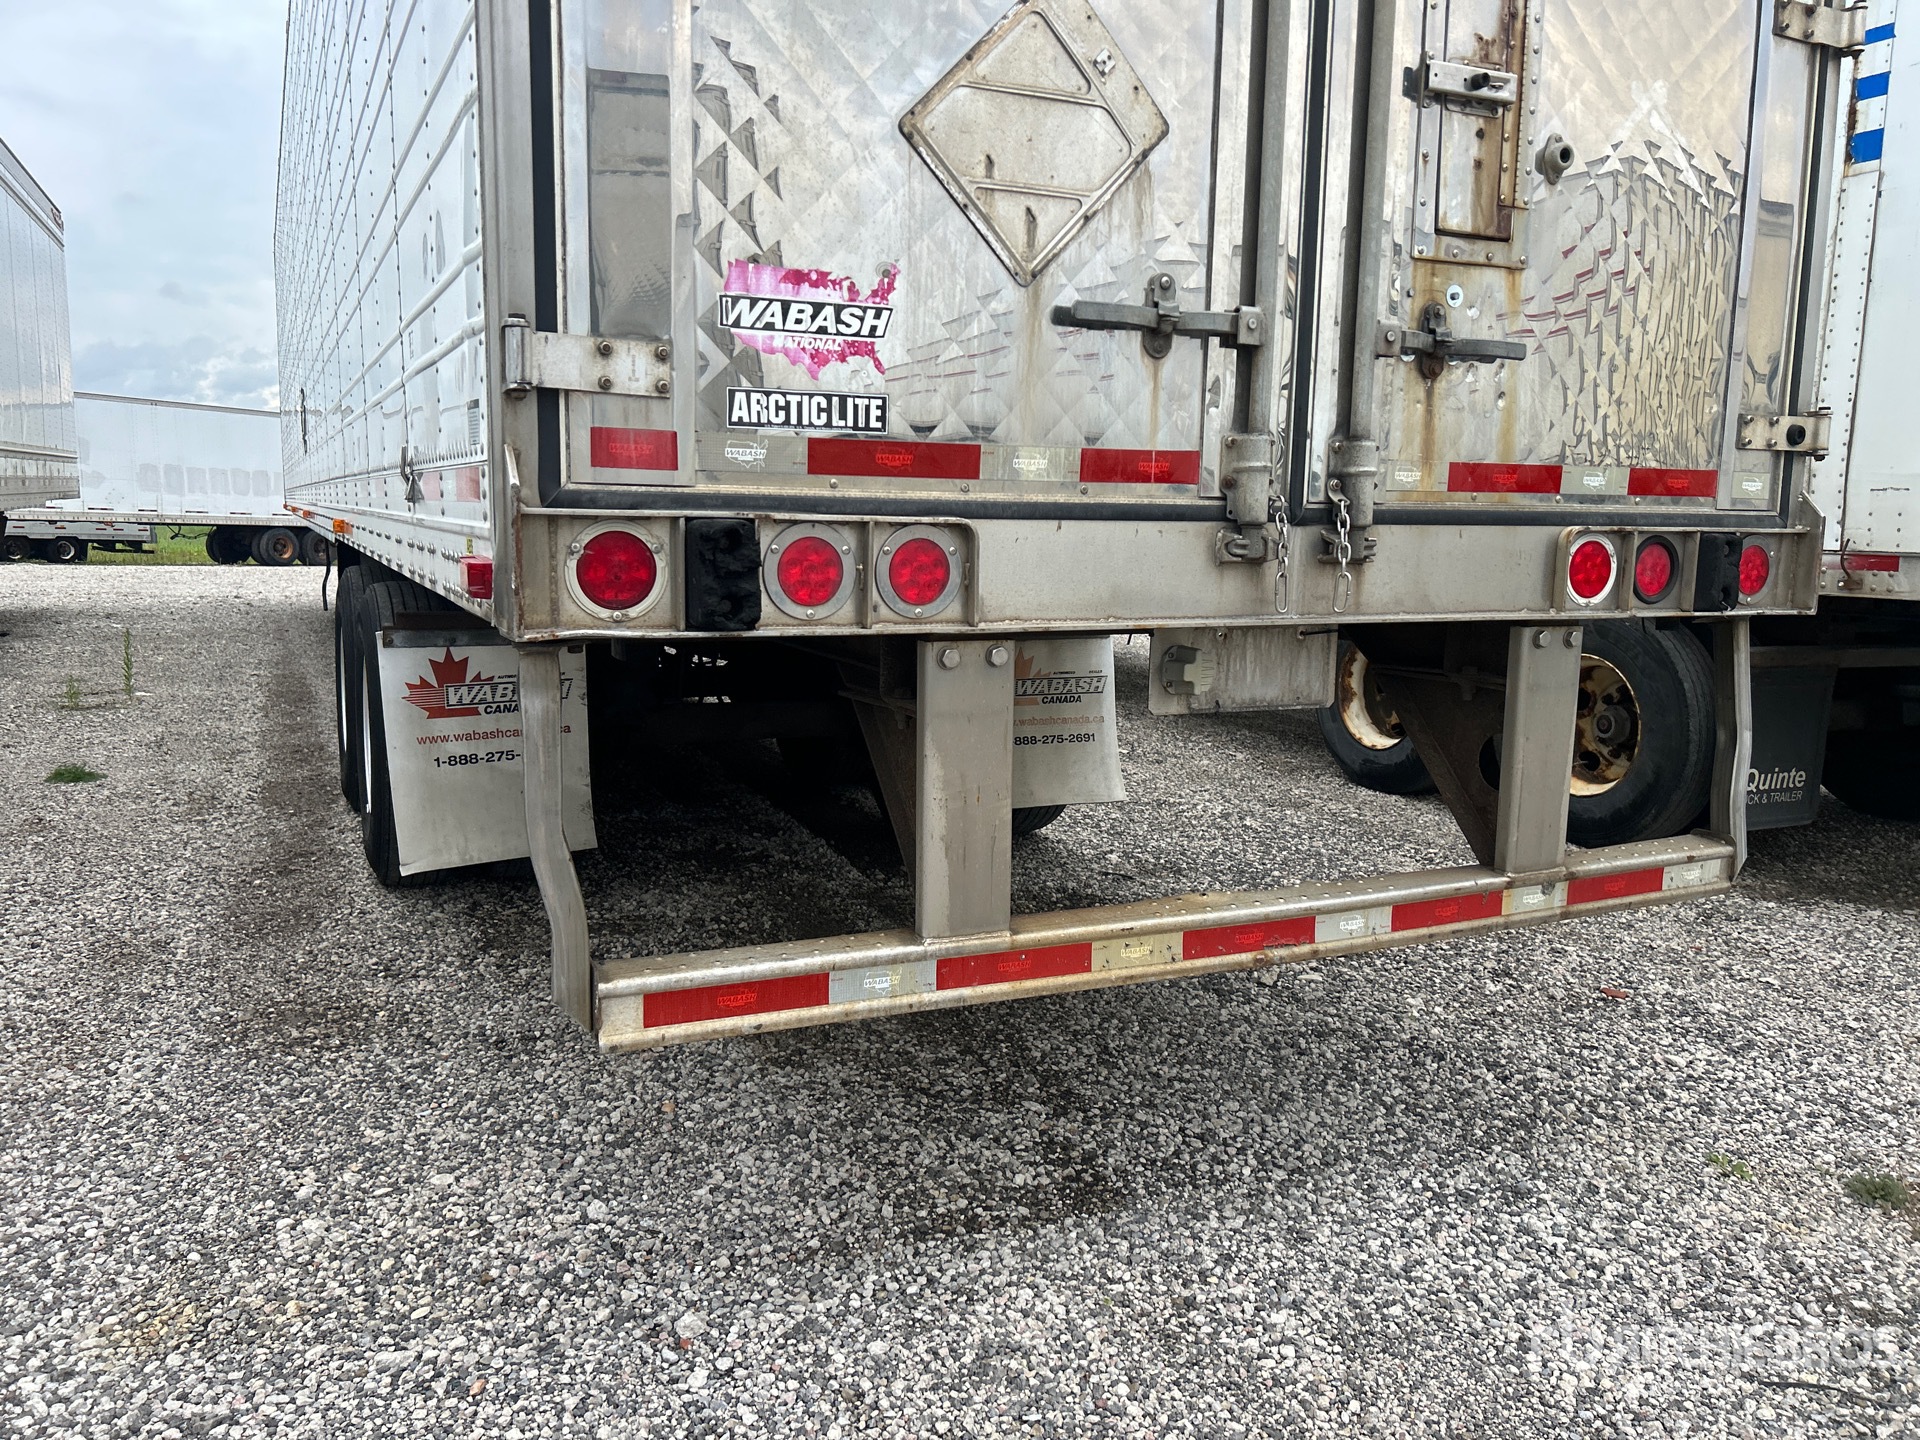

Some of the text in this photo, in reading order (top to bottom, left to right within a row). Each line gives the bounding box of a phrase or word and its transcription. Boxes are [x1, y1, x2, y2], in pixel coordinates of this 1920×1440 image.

[722, 296, 891, 337] WABASH
[731, 391, 883, 429] ARCTIC LITE
[725, 448, 766, 458] WABASH
[876, 454, 913, 464] WABASH
[1013, 459, 1047, 468] WABASH
[1395, 472, 1421, 480] WABASH
[1015, 677, 1105, 695] WABASH
[1041, 695, 1082, 705] CANADA
[484, 703, 519, 716] CANA
[1014, 715, 1105, 727] .wabashcanada.ca
[1014, 733, 1096, 746] 888-275-2691
[433, 749, 521, 768] 1-888-275-
[1747, 767, 1806, 793] Quinte
[1747, 791, 1803, 805] CK & TRAILER
[1121, 946, 1152, 957] WABASH
[998, 960, 1032, 971] WABASH
[863, 975, 901, 988] WABASH
[717, 992, 758, 1006] WABASH
